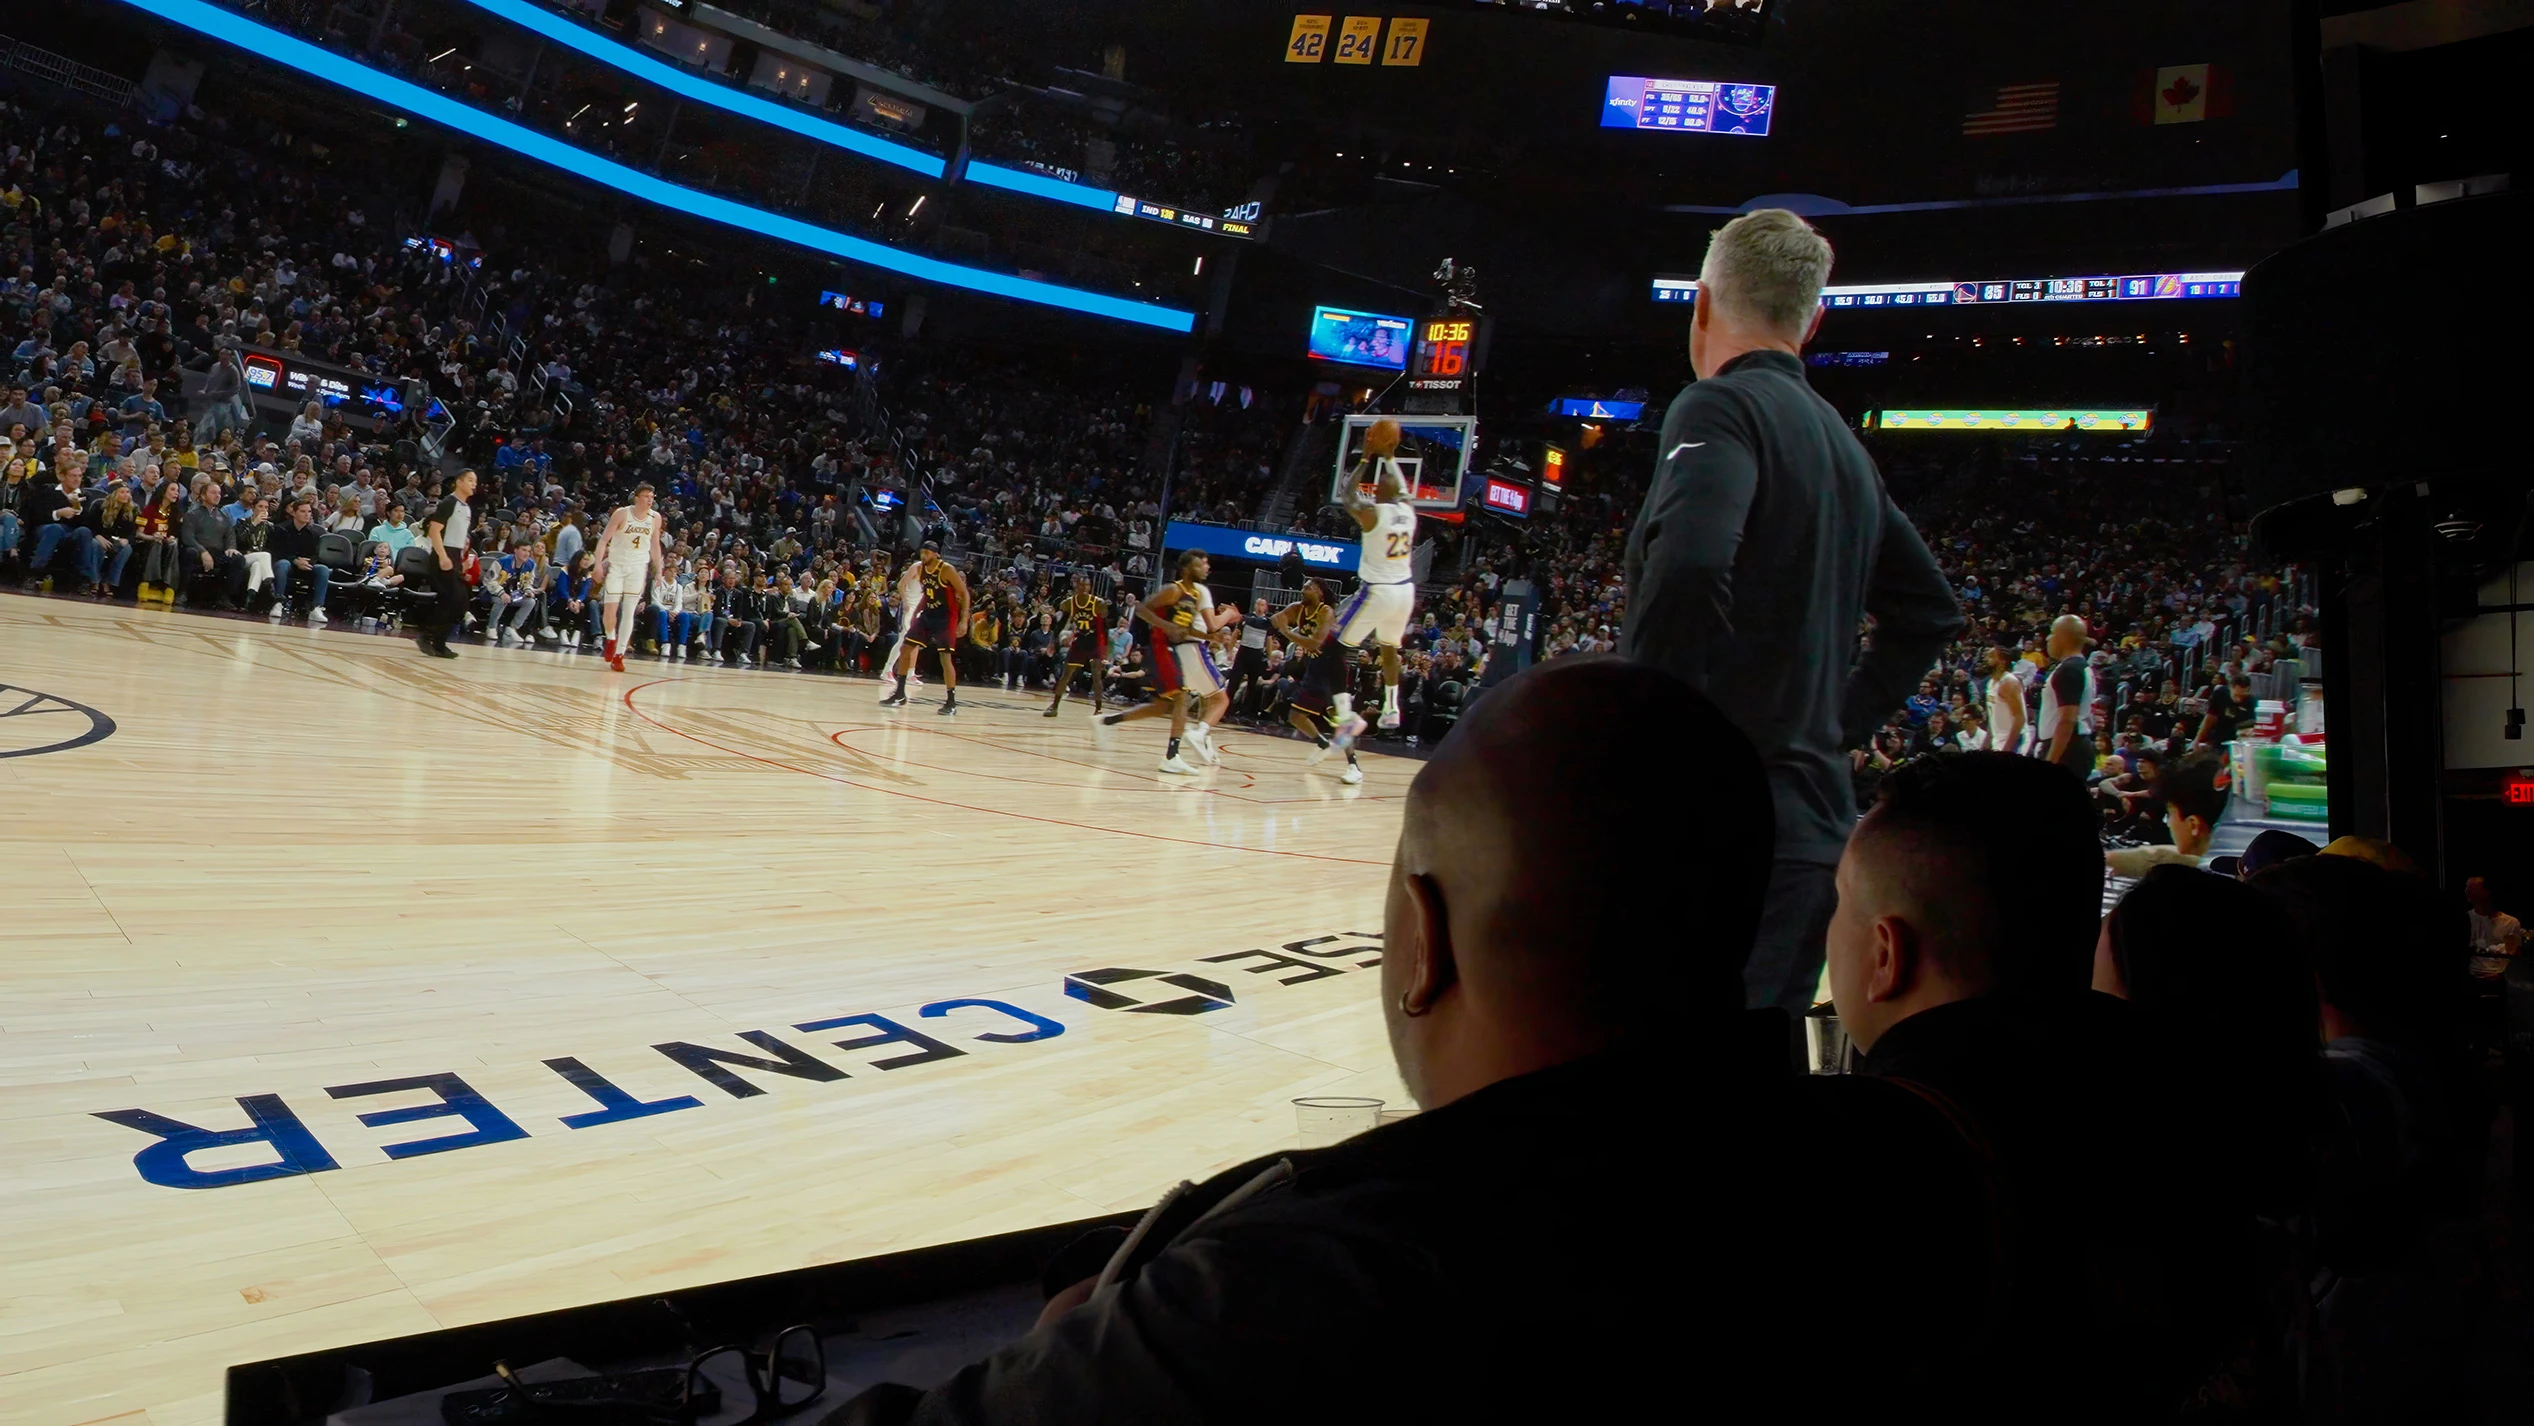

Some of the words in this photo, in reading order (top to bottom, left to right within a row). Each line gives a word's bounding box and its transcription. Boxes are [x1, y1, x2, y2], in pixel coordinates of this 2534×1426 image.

[1291, 33, 1324, 57] 42
[1338, 33, 1372, 58] 24
[1390, 36, 1418, 60] 17
[1141, 205, 1159, 215] IND
[1183, 215, 1201, 225] SAS
[1222, 223, 1249, 234] FINAL
[1984, 284, 2002, 300] 85
[2033, 282, 2041, 290] 3
[2048, 280, 2083, 294] 10:36
[2129, 279, 2147, 296] 91
[1428, 323, 1470, 342] 10:36
[1432, 342, 1464, 375] 16
[250, 368, 273, 381] 95.7
[329, 380, 349, 392] Dibs
[624, 525, 651, 535] LAKERS
[632, 536, 641, 549] 4
[1386, 531, 1411, 560] 23
[926, 588, 935, 600] 4
[1077, 620, 1090, 630] 71
[89, 1000, 1065, 1190] CENTER
